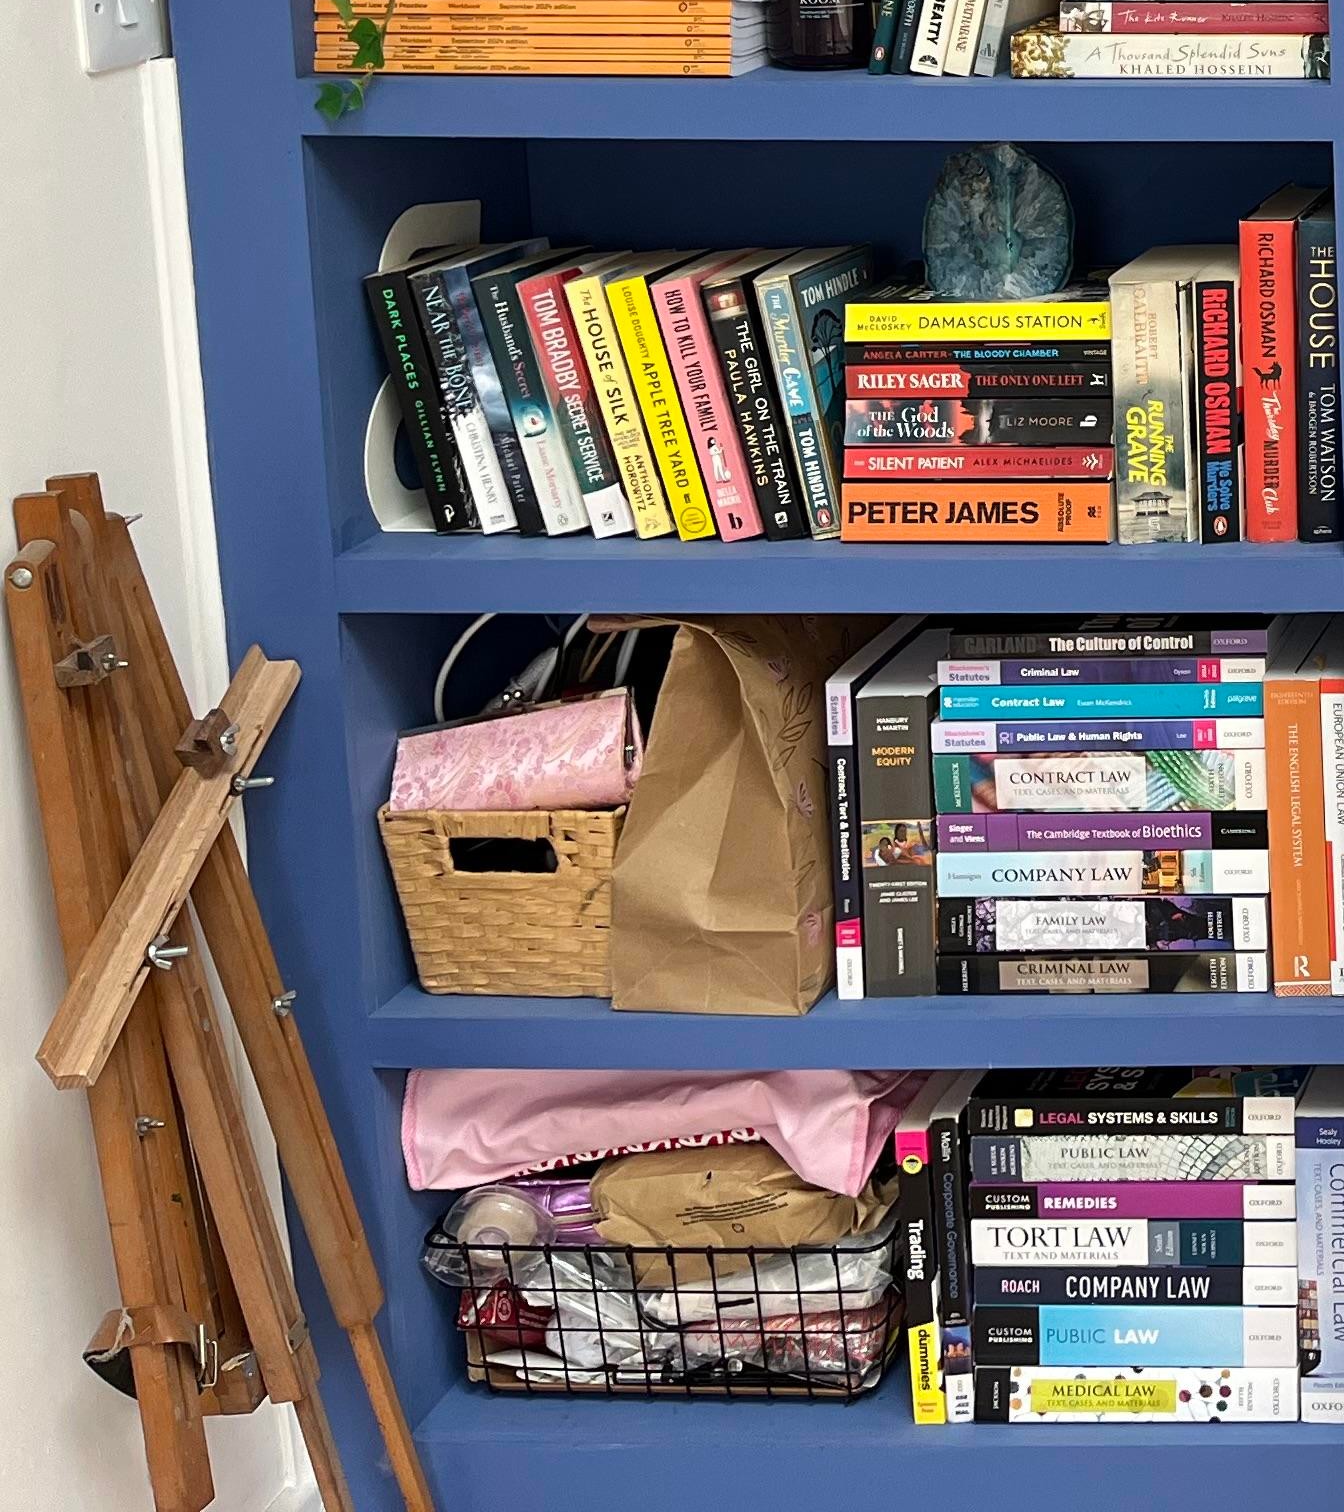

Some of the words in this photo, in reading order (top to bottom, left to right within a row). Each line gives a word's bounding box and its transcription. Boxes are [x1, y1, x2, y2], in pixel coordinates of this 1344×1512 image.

[1119, 65, 1187, 76] KHALED
[1194, 64, 1273, 76] HOSSEINI
[918, 317, 1010, 329] DAMASCUS
[1015, 316, 1082, 329] STATION
[1201, 288, 1220, 379] RICHARD
[1205, 383, 1232, 455] OSMAN
[848, 502, 939, 525] PETER
[944, 501, 1040, 524] JAMES
[872, 746, 915, 756] MODERN
[876, 756, 912, 767] EQUITY
[991, 868, 1087, 883] COMPANY
[1091, 867, 1132, 882] LAW
[987, 1226, 1067, 1248] TORT
[1073, 1227, 1132, 1247] LAW
[907, 1219, 924, 1281] Trading
[1066, 1278, 1162, 1299] COMPANY
[1167, 1277, 1210, 1298] LAW
